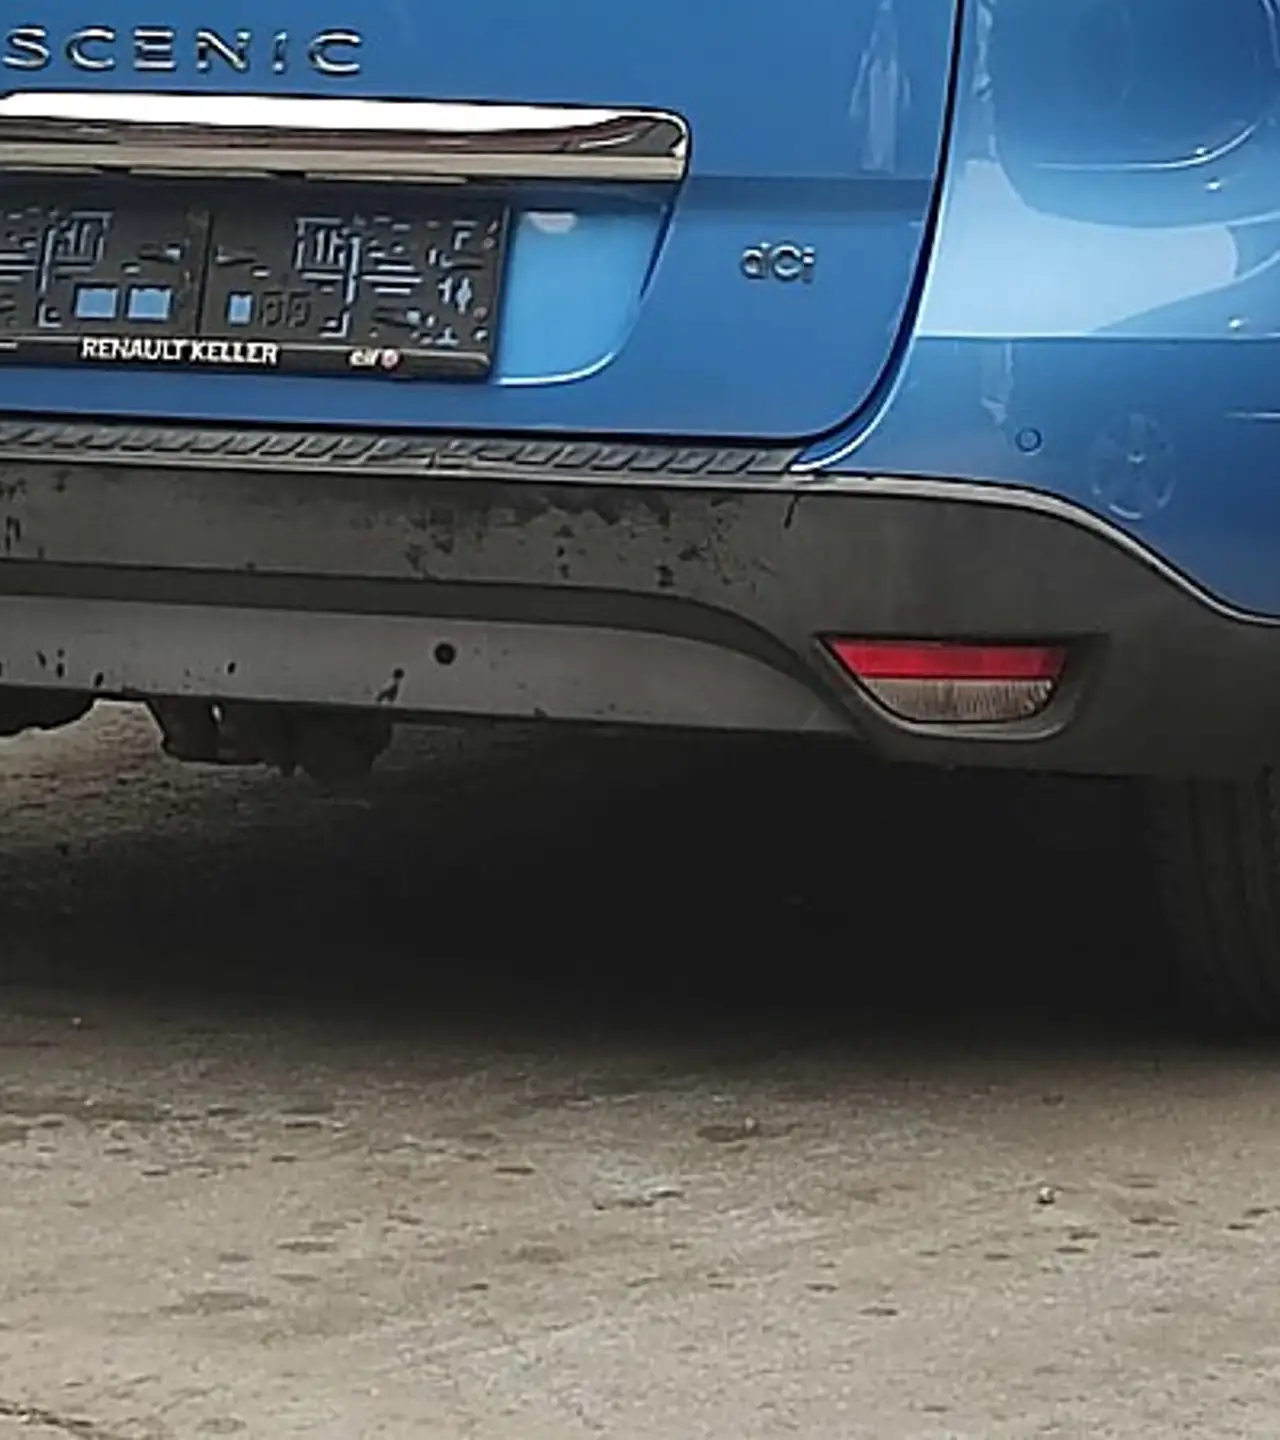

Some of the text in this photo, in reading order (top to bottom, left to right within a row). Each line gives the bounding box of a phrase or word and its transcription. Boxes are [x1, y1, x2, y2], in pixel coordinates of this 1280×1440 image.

[1, 24, 362, 77] SCENIC
[81, 337, 279, 366] RENAULT KELLER
